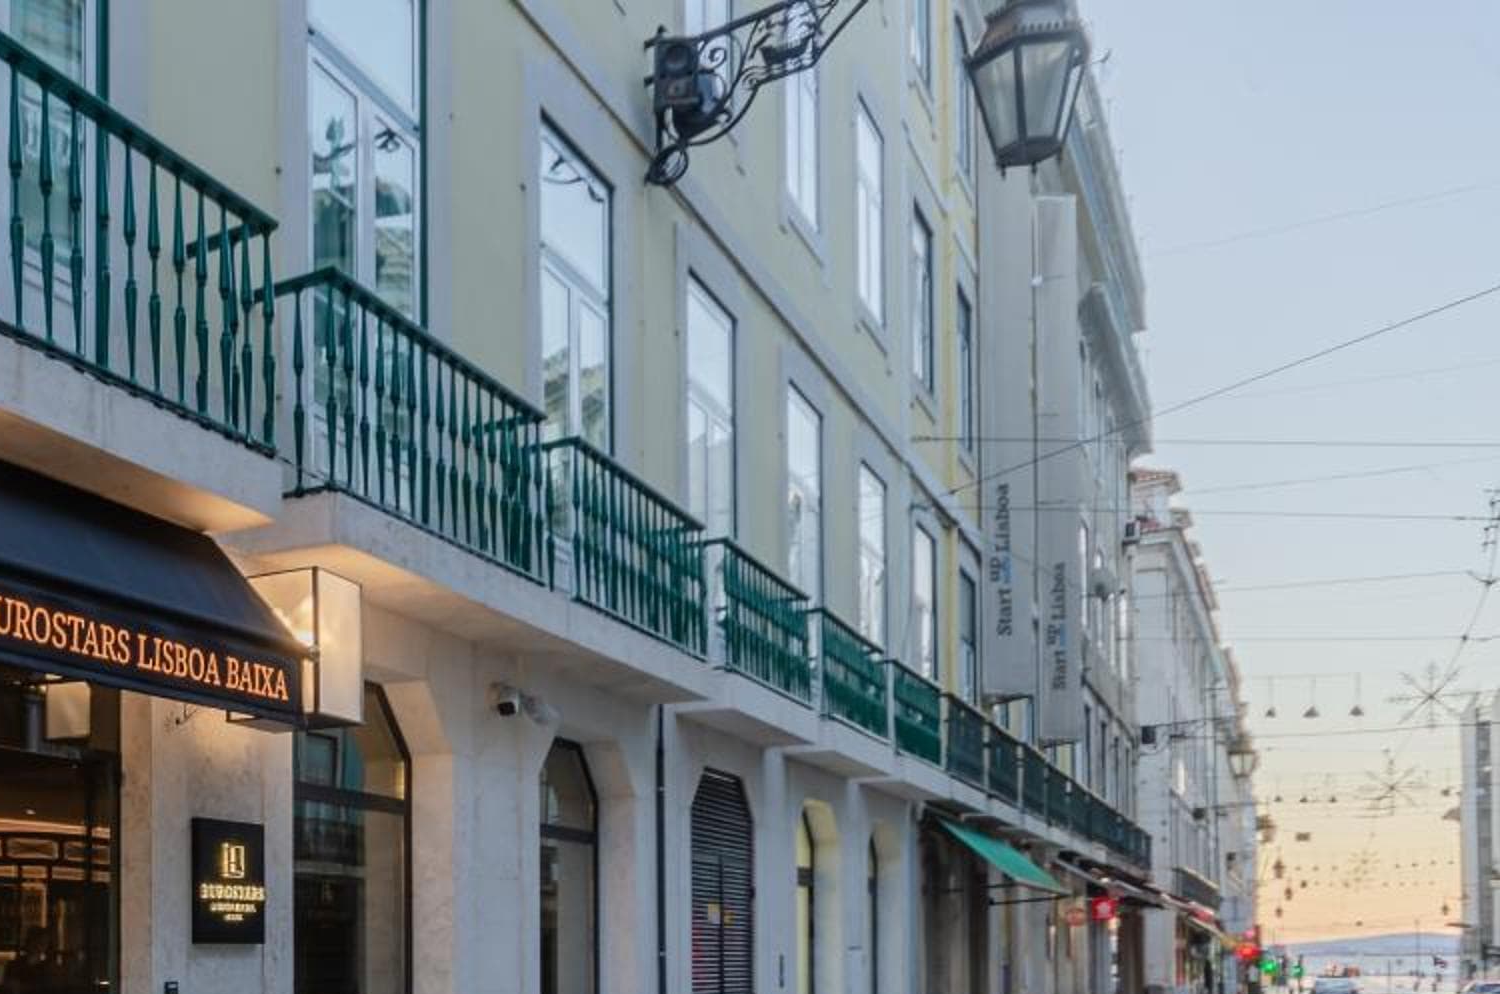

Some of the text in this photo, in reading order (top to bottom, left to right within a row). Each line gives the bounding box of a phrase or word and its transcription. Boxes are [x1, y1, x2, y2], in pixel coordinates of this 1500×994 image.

[989, 483, 1013, 637] Start up Lisboa
[136, 633, 221, 686] LISBOA
[225, 655, 289, 700] BAIXA
